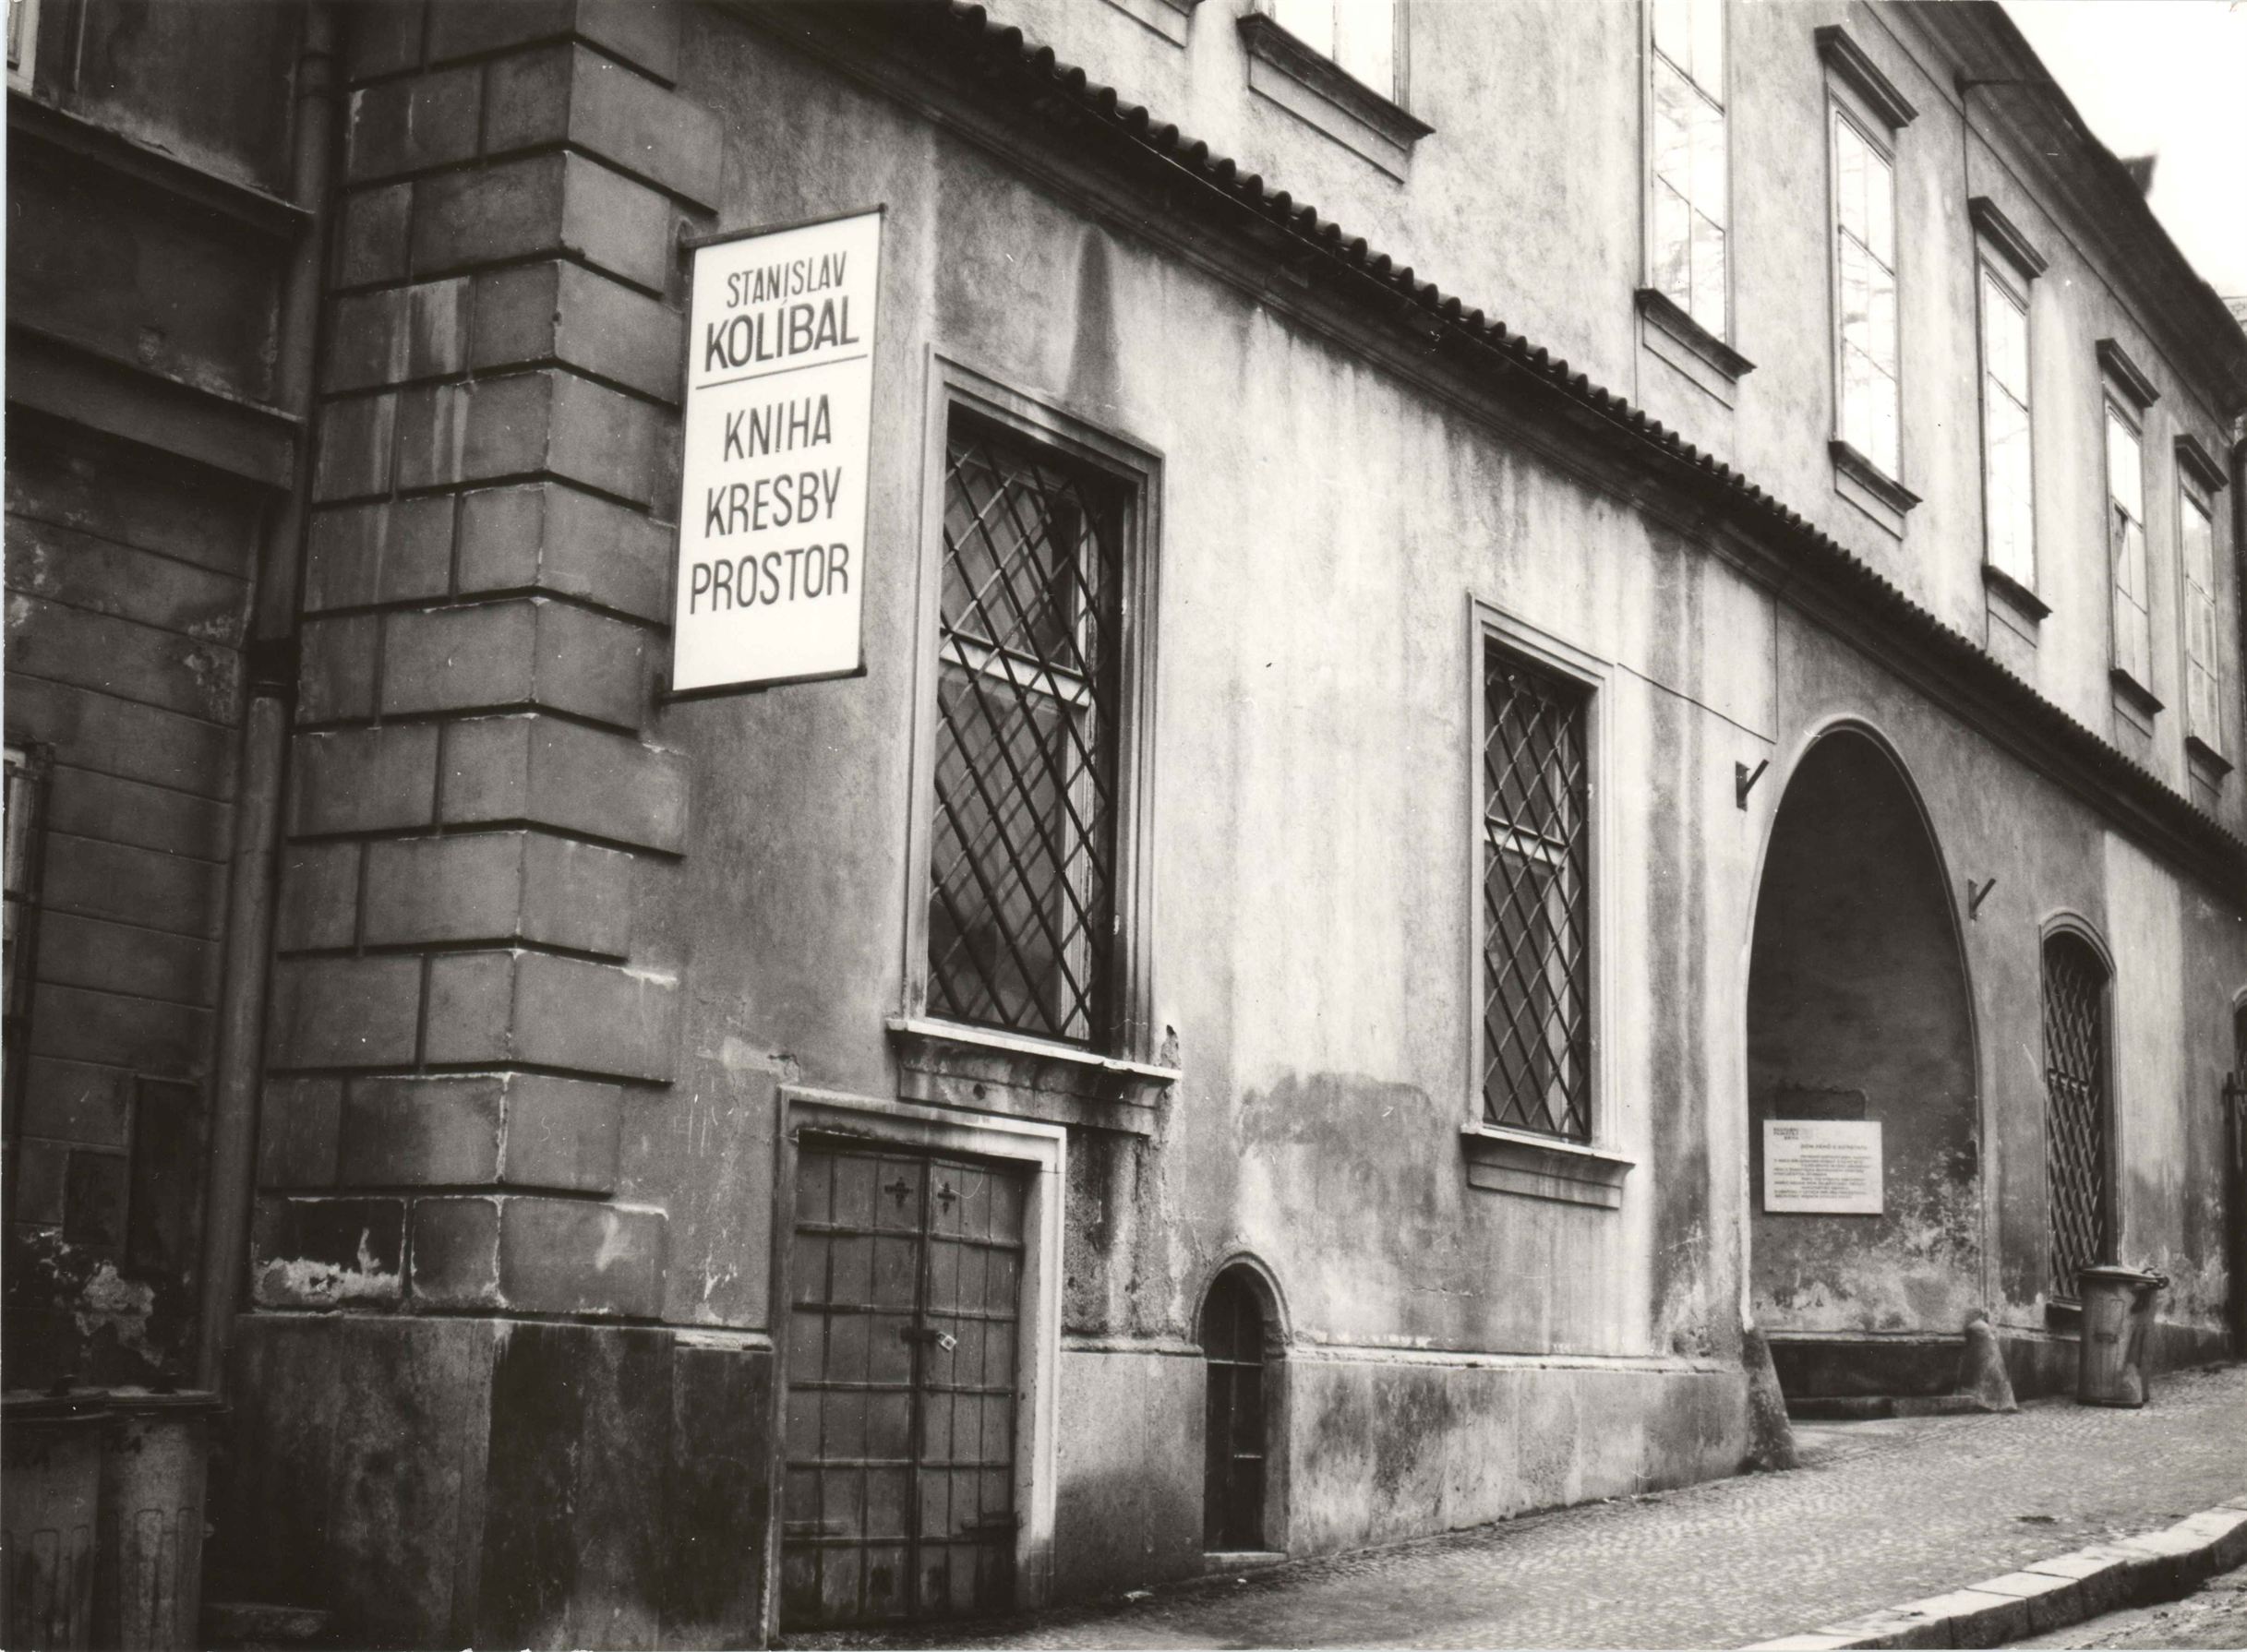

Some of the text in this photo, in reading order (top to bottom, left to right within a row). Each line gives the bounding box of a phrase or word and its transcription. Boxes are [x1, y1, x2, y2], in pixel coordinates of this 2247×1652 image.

[727, 250, 847, 309] STANISLAV
[704, 294, 859, 372] KOLÍBAL
[723, 393, 832, 461] KNIHA
[704, 466, 842, 538] KRESBY
[690, 543, 849, 615] PROSTOR
